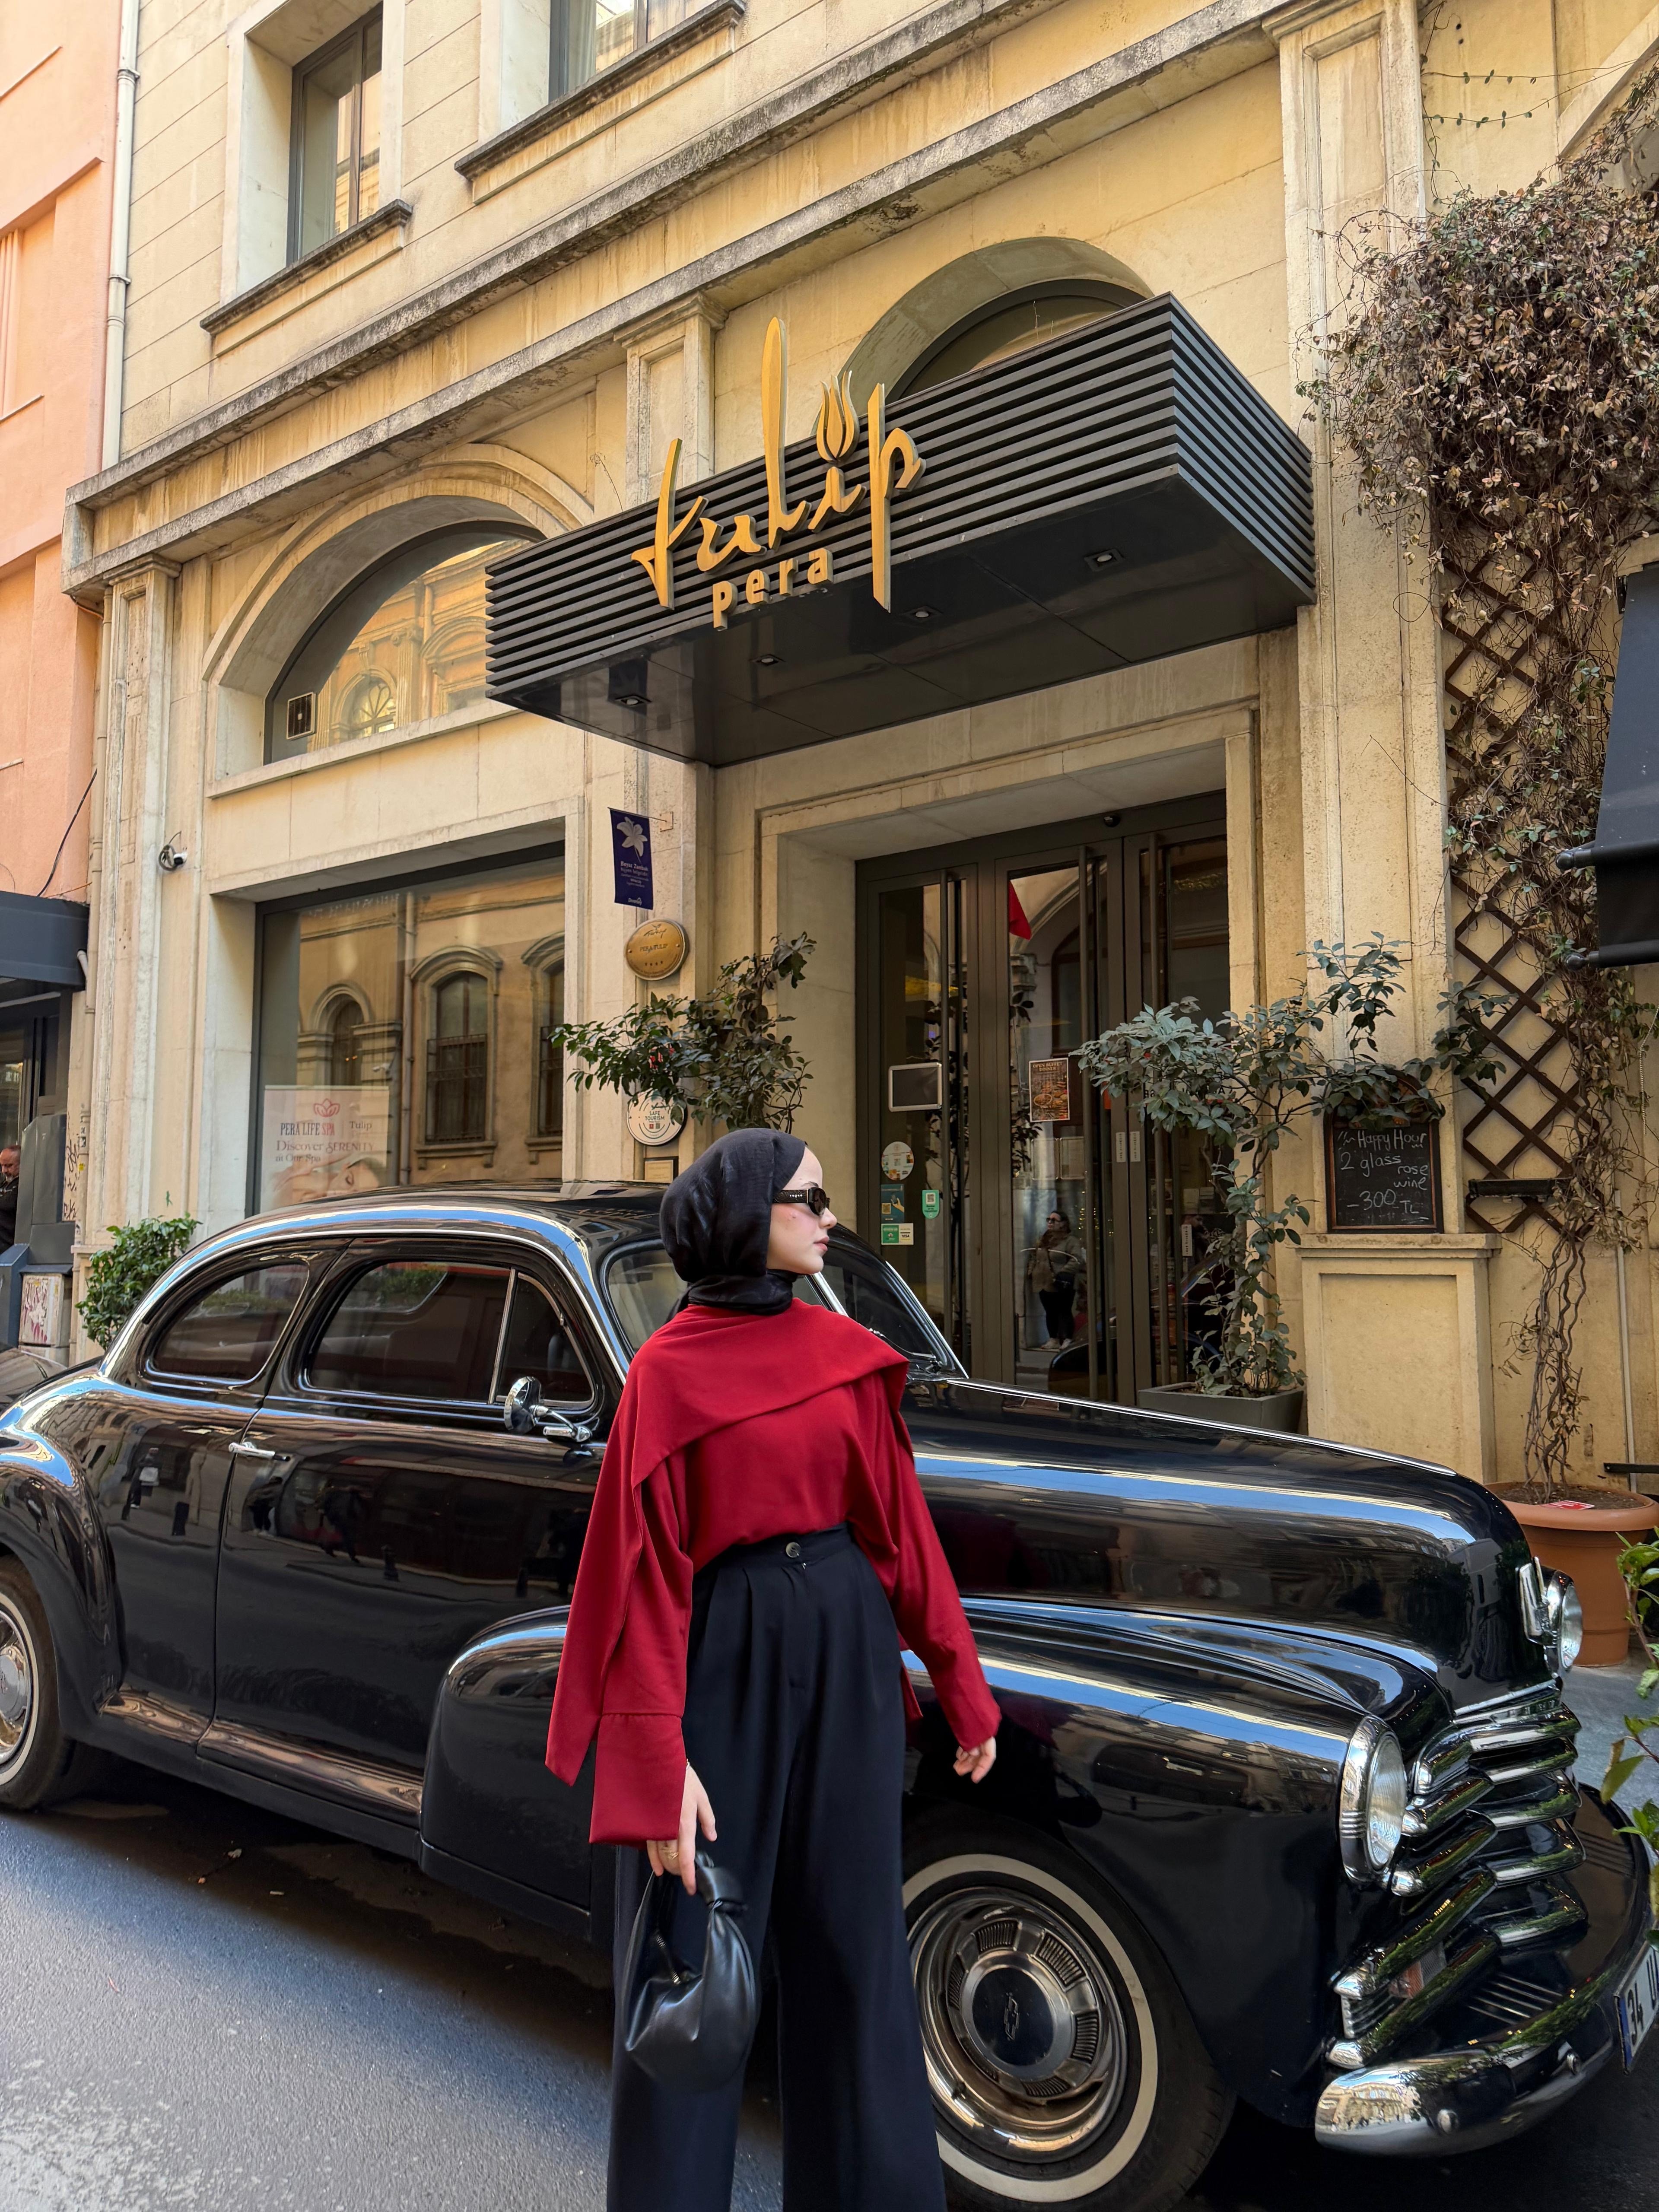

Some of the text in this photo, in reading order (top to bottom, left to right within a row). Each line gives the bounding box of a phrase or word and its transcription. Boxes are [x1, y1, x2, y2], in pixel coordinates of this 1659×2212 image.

[712, 548, 833, 630] pera
[280, 1122, 335, 1135] PERA LIFE SPA
[349, 1121, 372, 1131] Tulip
[1357, 1129, 1427, 1151] Happy Hour
[276, 1140, 374, 1154] Discover SERENITY
[305, 1154, 321, 1164] Spa
[1341, 1152, 1402, 1177] 2 glass
[1398, 1165, 1428, 1176] rose
[1393, 1177, 1427, 1190] wine
[1627, 1980, 1643, 2045] 34
